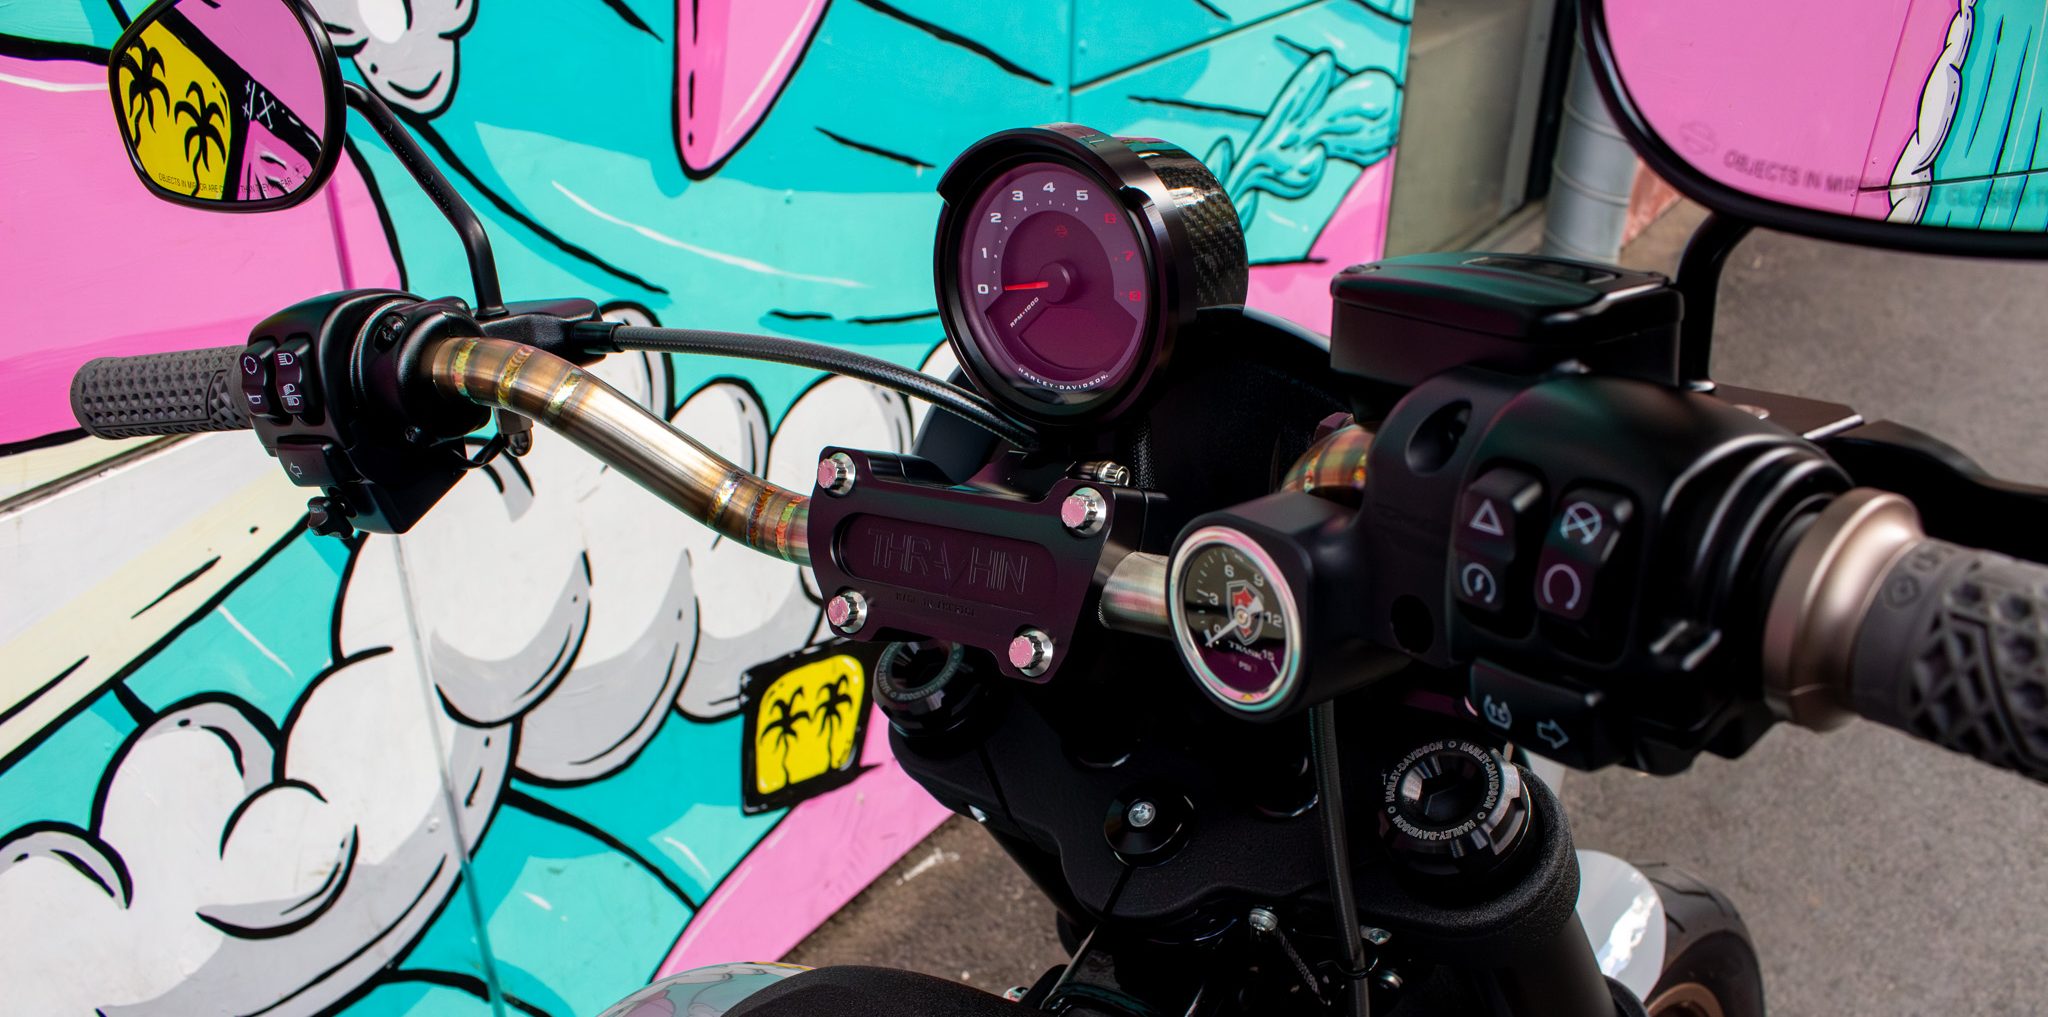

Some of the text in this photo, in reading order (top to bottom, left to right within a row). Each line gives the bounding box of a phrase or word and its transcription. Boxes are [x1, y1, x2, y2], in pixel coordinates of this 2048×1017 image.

[1723, 150, 1800, 186] OBJECTS
[1803, 170, 1821, 188] IN
[1043, 182, 1055, 192] 4
[1012, 190, 1024, 201] 3
[1076, 190, 1088, 201] 5
[990, 213, 1002, 223] 2
[1104, 213, 1117, 224] 6
[982, 247, 988, 258] 1
[1122, 250, 1134, 262] 7
[977, 284, 989, 295] 0
[867, 527, 1029, 595] THRAHIN
[1224, 564, 1235, 578] 6
[1253, 574, 1264, 588] 9
[1209, 592, 1219, 606] 3
[1264, 611, 1283, 628] 12
[1385, 740, 1444, 803] HARLEY-DAVIDSON
[1459, 741, 1500, 810] HARLEY-DAVIDSON
[1391, 814, 1477, 841] HARLEY-DAVIDSON
